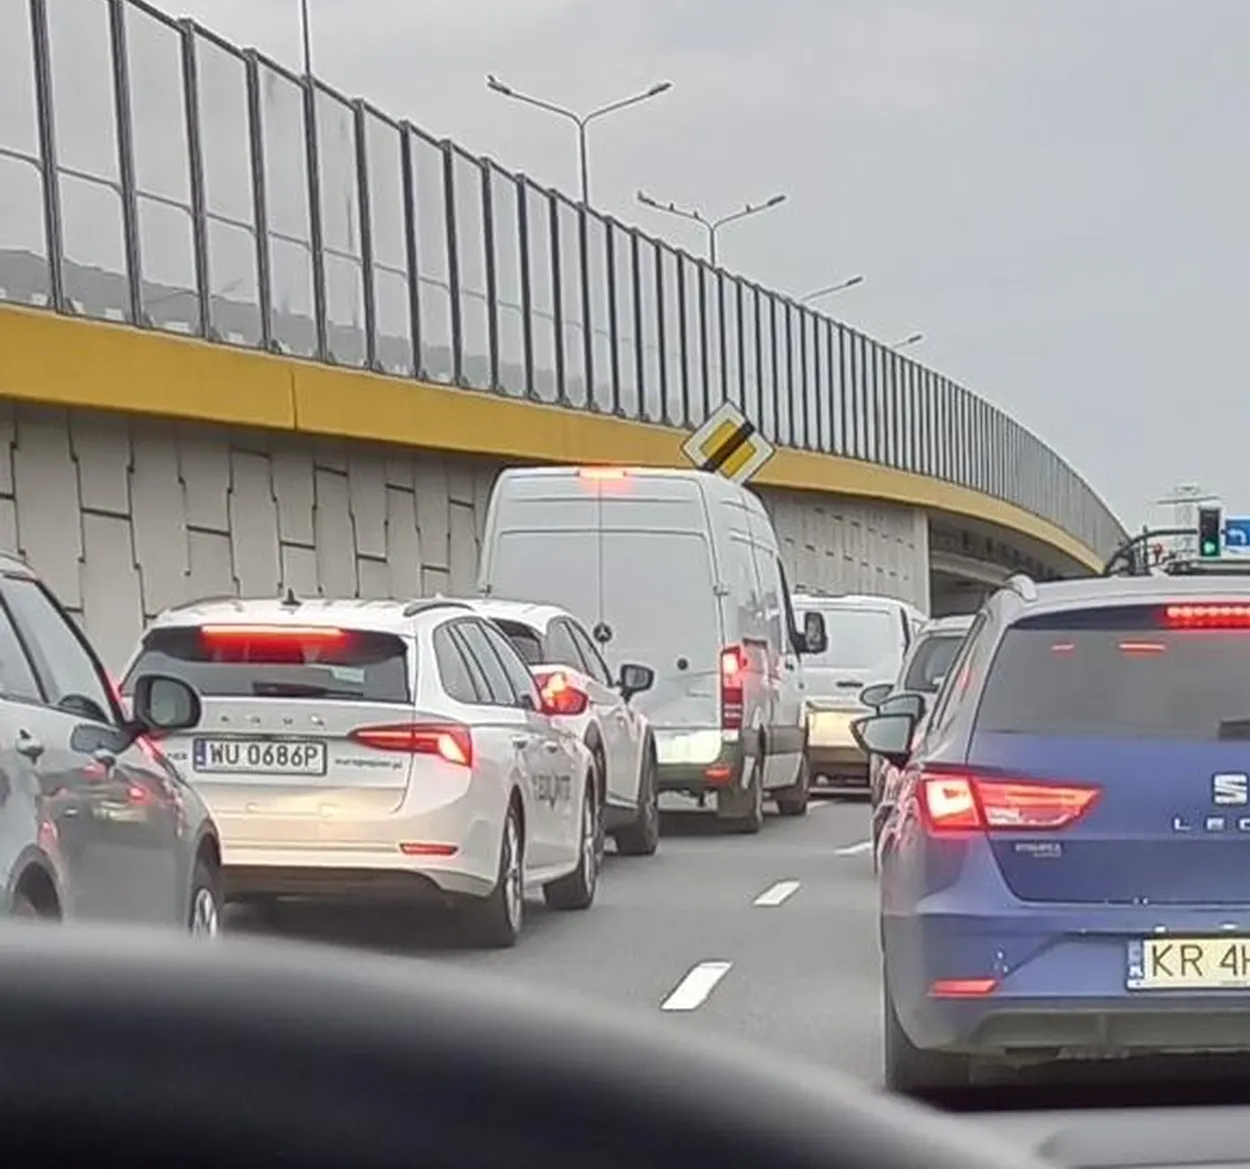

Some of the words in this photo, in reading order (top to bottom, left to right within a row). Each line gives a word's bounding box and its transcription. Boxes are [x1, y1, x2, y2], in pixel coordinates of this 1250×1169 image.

[209, 742, 240, 765] WU
[247, 744, 318, 767] 0686P
[1151, 943, 1204, 977] KR
